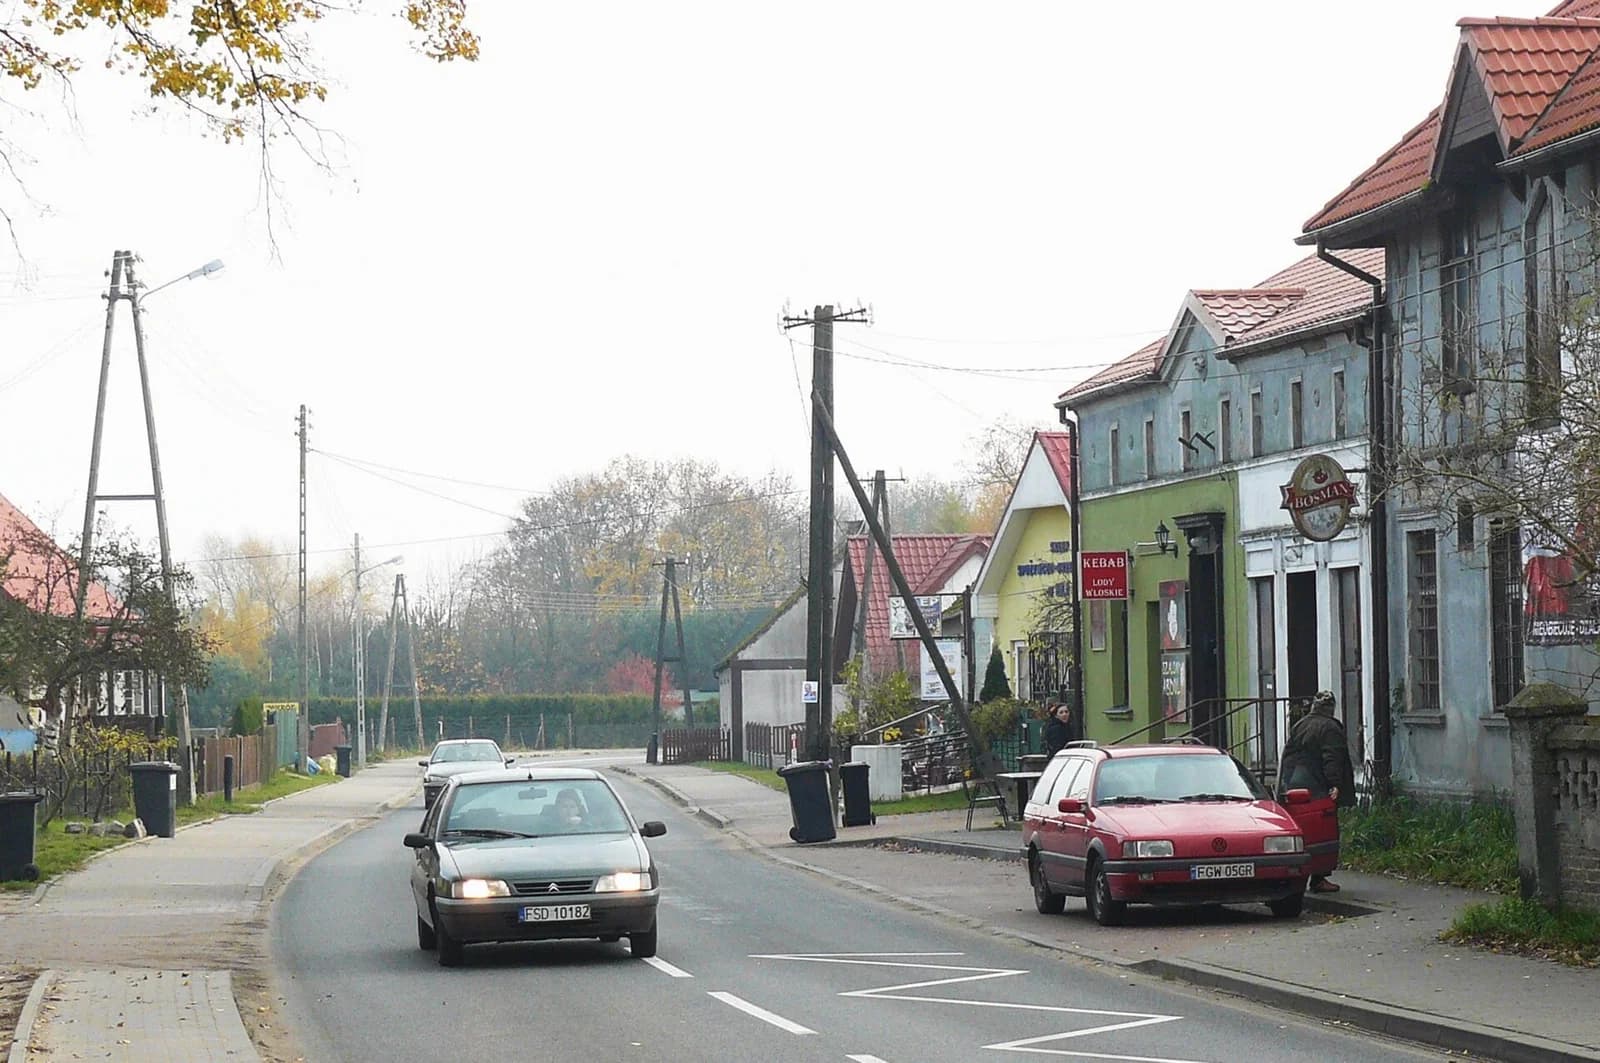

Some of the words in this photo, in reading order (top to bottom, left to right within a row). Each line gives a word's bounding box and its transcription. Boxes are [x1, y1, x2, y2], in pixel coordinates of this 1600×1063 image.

[1295, 483, 1349, 508] BOSMAN
[1083, 557, 1124, 568] KEBAB
[1092, 577, 1115, 587] LODY
[1197, 865, 1221, 878] FGW
[1225, 864, 1253, 877] 05GR
[525, 907, 549, 920] FSD
[554, 905, 590, 919] 10182
